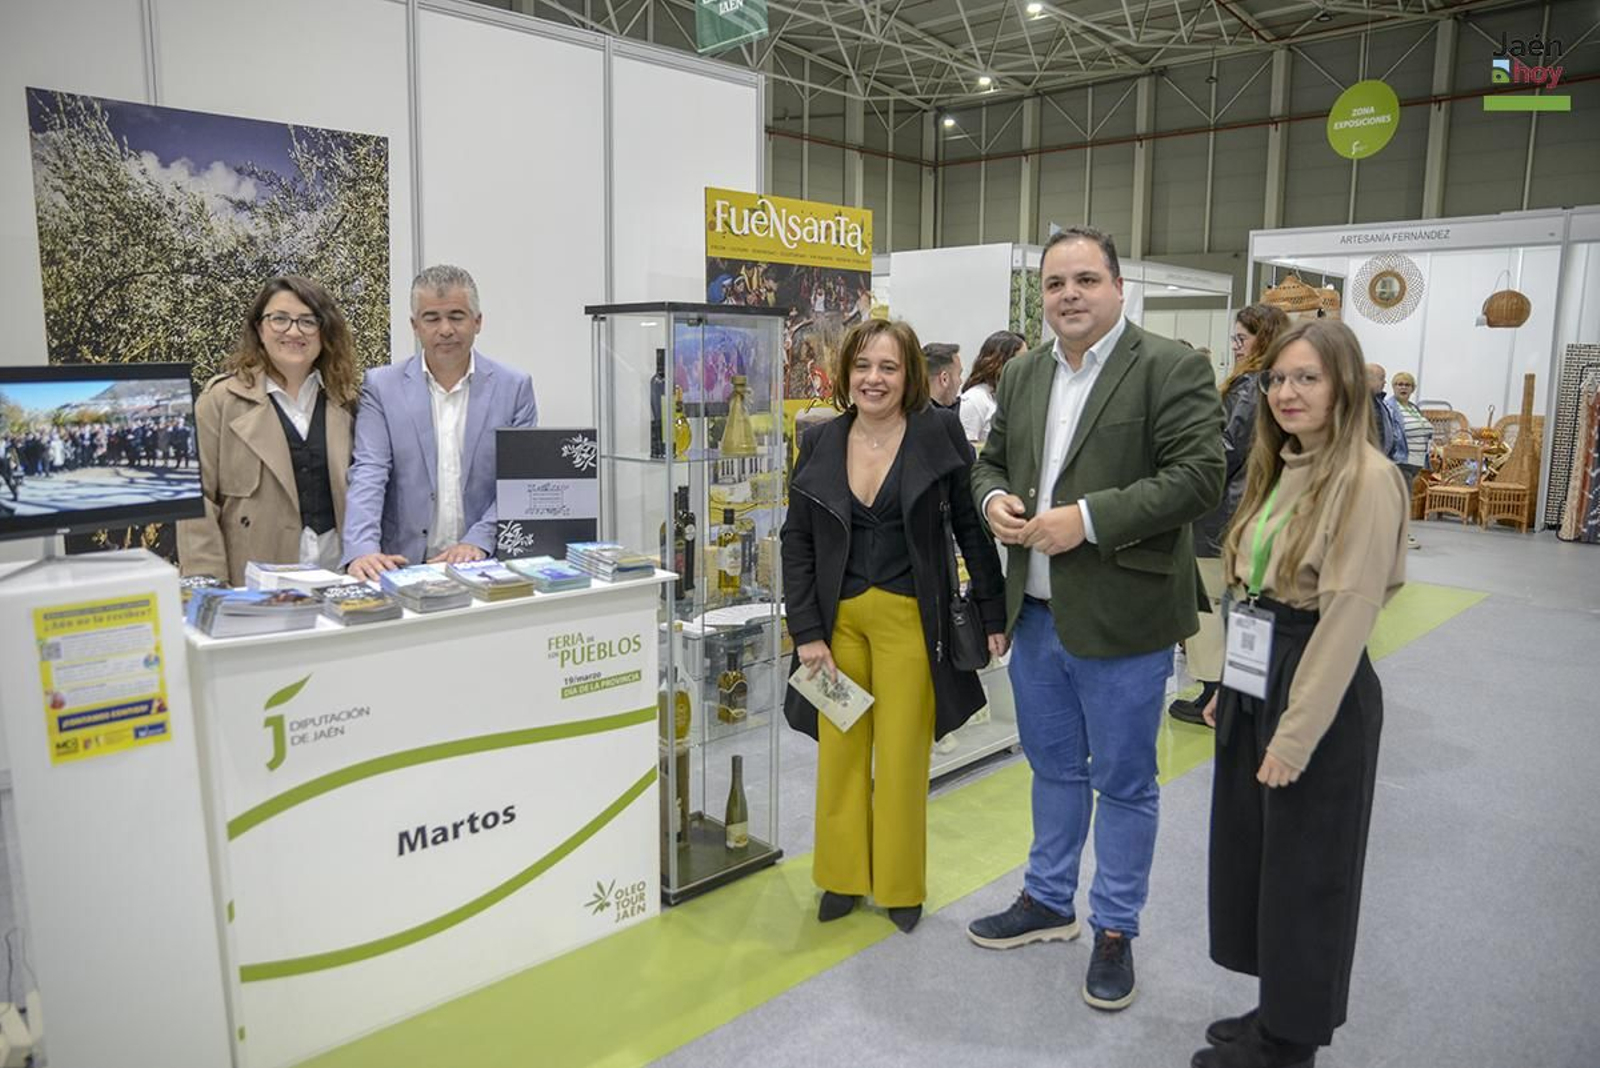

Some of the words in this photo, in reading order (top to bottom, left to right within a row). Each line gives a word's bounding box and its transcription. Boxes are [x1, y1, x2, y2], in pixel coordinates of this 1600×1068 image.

[1352, 106, 1375, 117] ZONA
[1333, 114, 1391, 130] EXPOSICIONES
[1339, 231, 1391, 245] ARTESANÍA
[1392, 229, 1450, 242] FERNÁNDEZ
[547, 632, 585, 651] FERIA
[560, 634, 642, 668] PUEBLOS
[564, 671, 602, 685] 19/marzo
[289, 706, 371, 732] DIPUTACIÓN
[290, 733, 309, 746] DE
[397, 804, 516, 857] Martos
[614, 880, 646, 900] OLEO
[615, 892, 646, 909] TOUR
